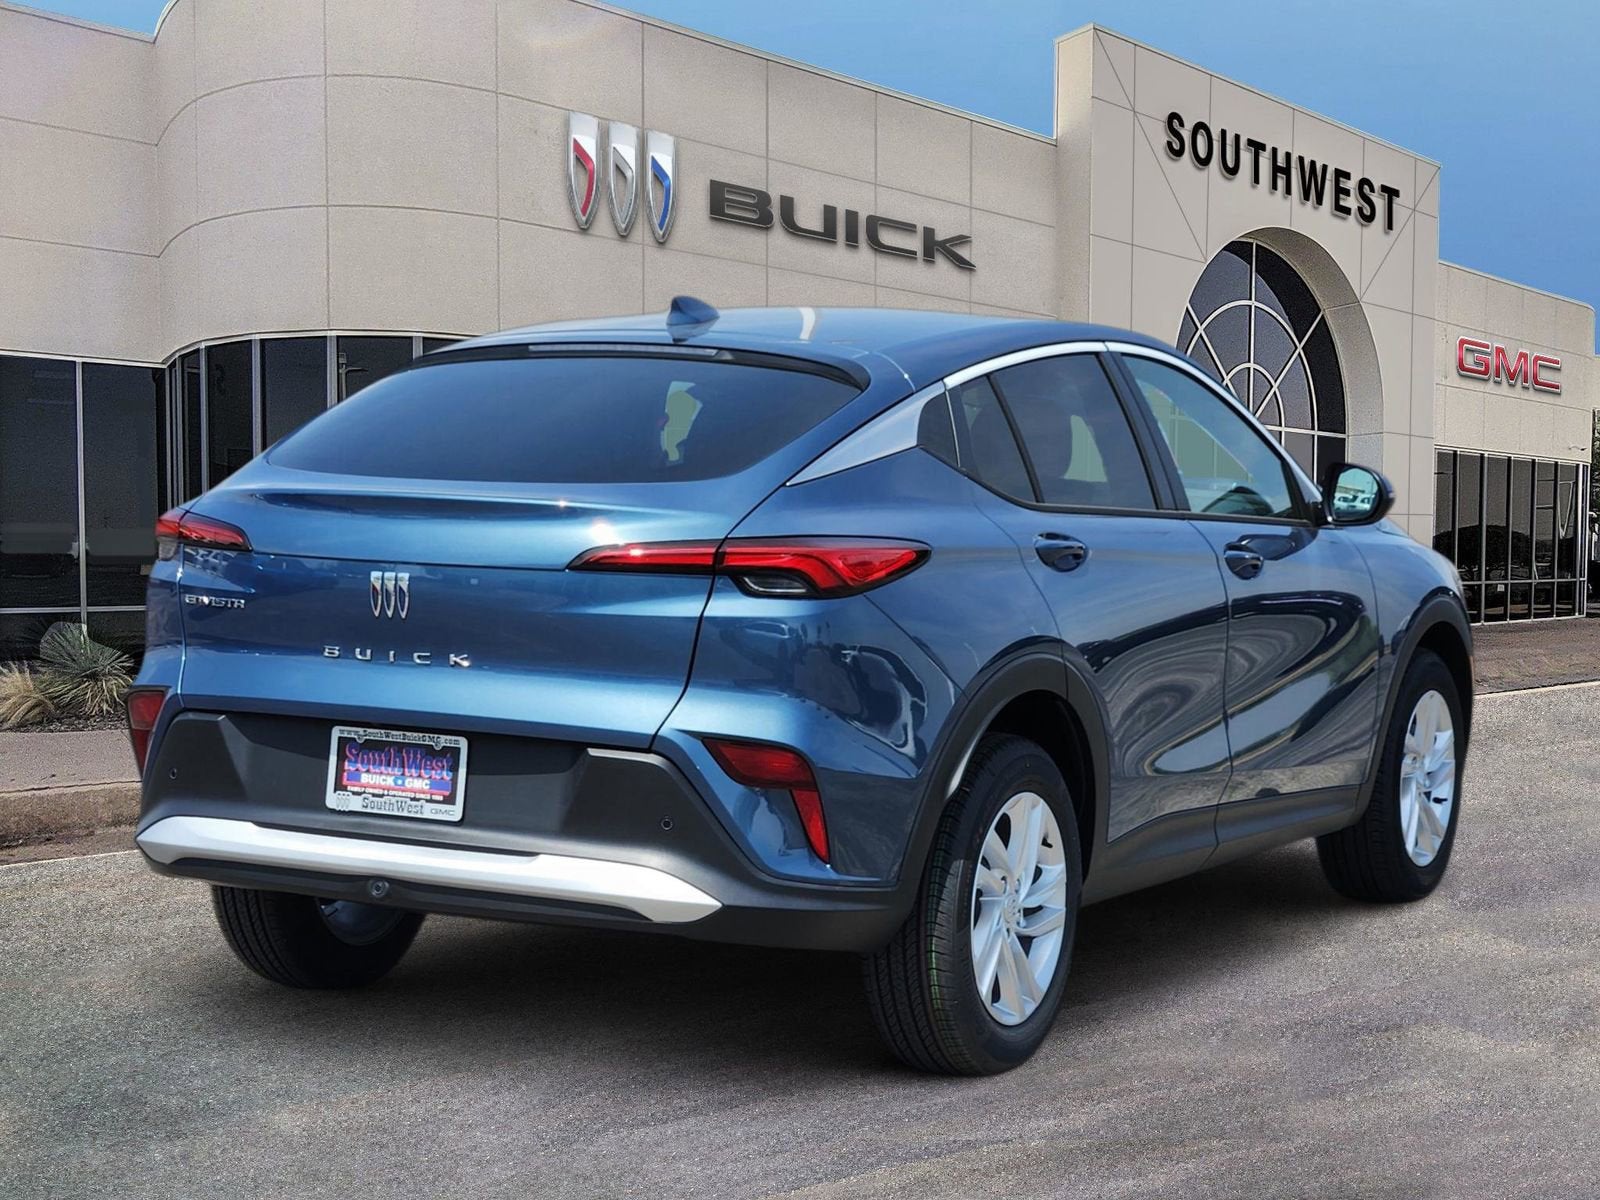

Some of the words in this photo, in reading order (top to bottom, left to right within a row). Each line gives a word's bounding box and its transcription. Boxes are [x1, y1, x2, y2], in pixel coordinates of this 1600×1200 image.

[1165, 111, 1401, 233] SOUTHWEST
[709, 178, 978, 270] BUICK
[1456, 335, 1562, 394] GMC
[323, 645, 472, 668] BUICK
[360, 773, 395, 785] BUICK
[404, 777, 431, 789] GMC
[362, 797, 424, 815] SouthWest
[430, 808, 456, 817] GMC
